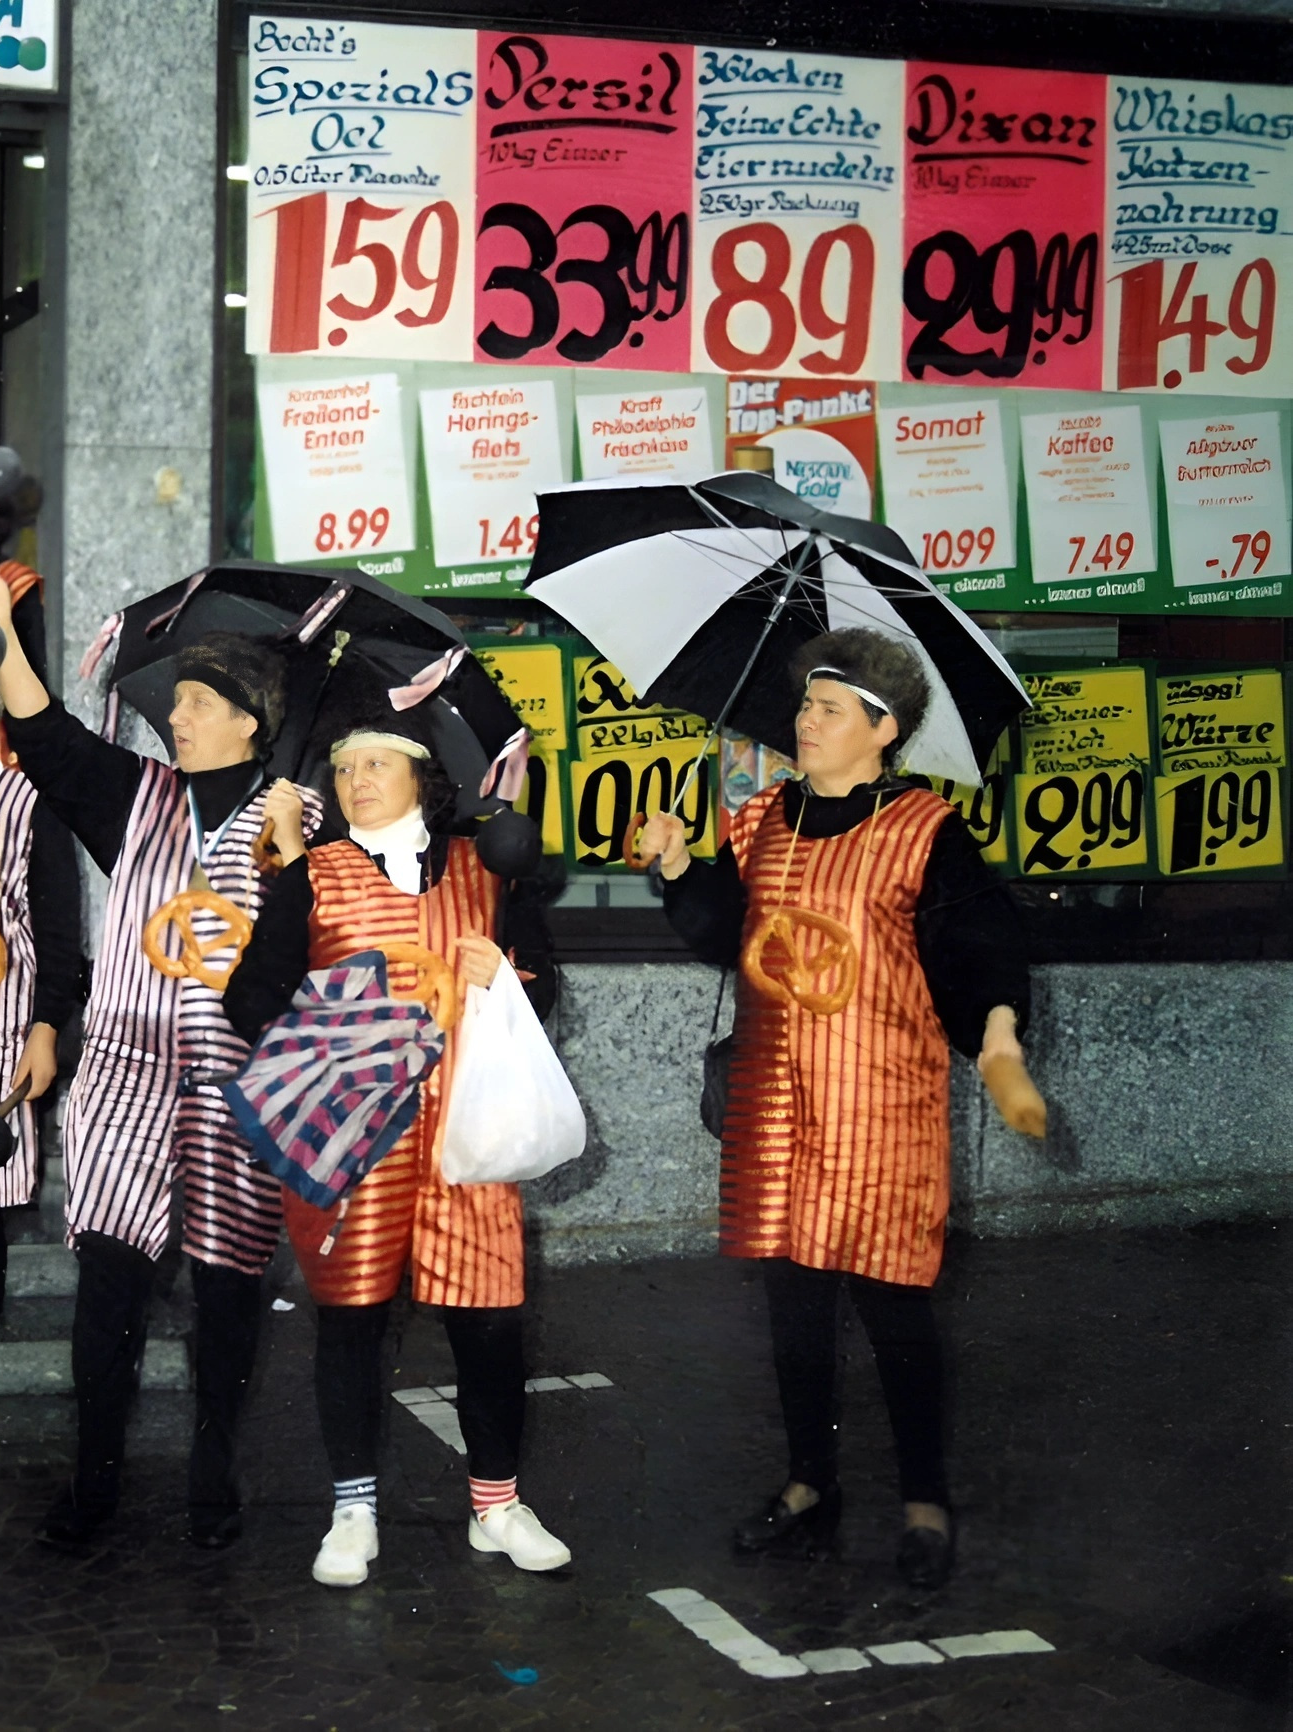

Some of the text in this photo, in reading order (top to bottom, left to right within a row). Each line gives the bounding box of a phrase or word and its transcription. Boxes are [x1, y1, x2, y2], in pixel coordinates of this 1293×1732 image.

[484, 36, 682, 116] Persil
[908, 74, 1097, 149] Dixan
[1114, 86, 1293, 139] Whiskas
[254, 191, 459, 354] 1.59
[477, 202, 689, 362] 33.99
[704, 222, 875, 376] 89
[903, 229, 1099, 380] 29.99
[1107, 258, 1277, 391] 1.49
[727, 388, 872, 434] Top-Punkt
[728, 380, 780, 408] Der
[303, 429, 365, 450] Enten
[895, 410, 986, 442] Somat
[1047, 432, 1114, 456] Kaffee
[796, 478, 842, 498] Gold
[314, 507, 390, 553] 8.99
[1068, 532, 1135, 574] 7.49
[1161, 712, 1275, 750] Würze
[1023, 769, 1143, 874] 2.99
[1158, 770, 1272, 873] 1.99
